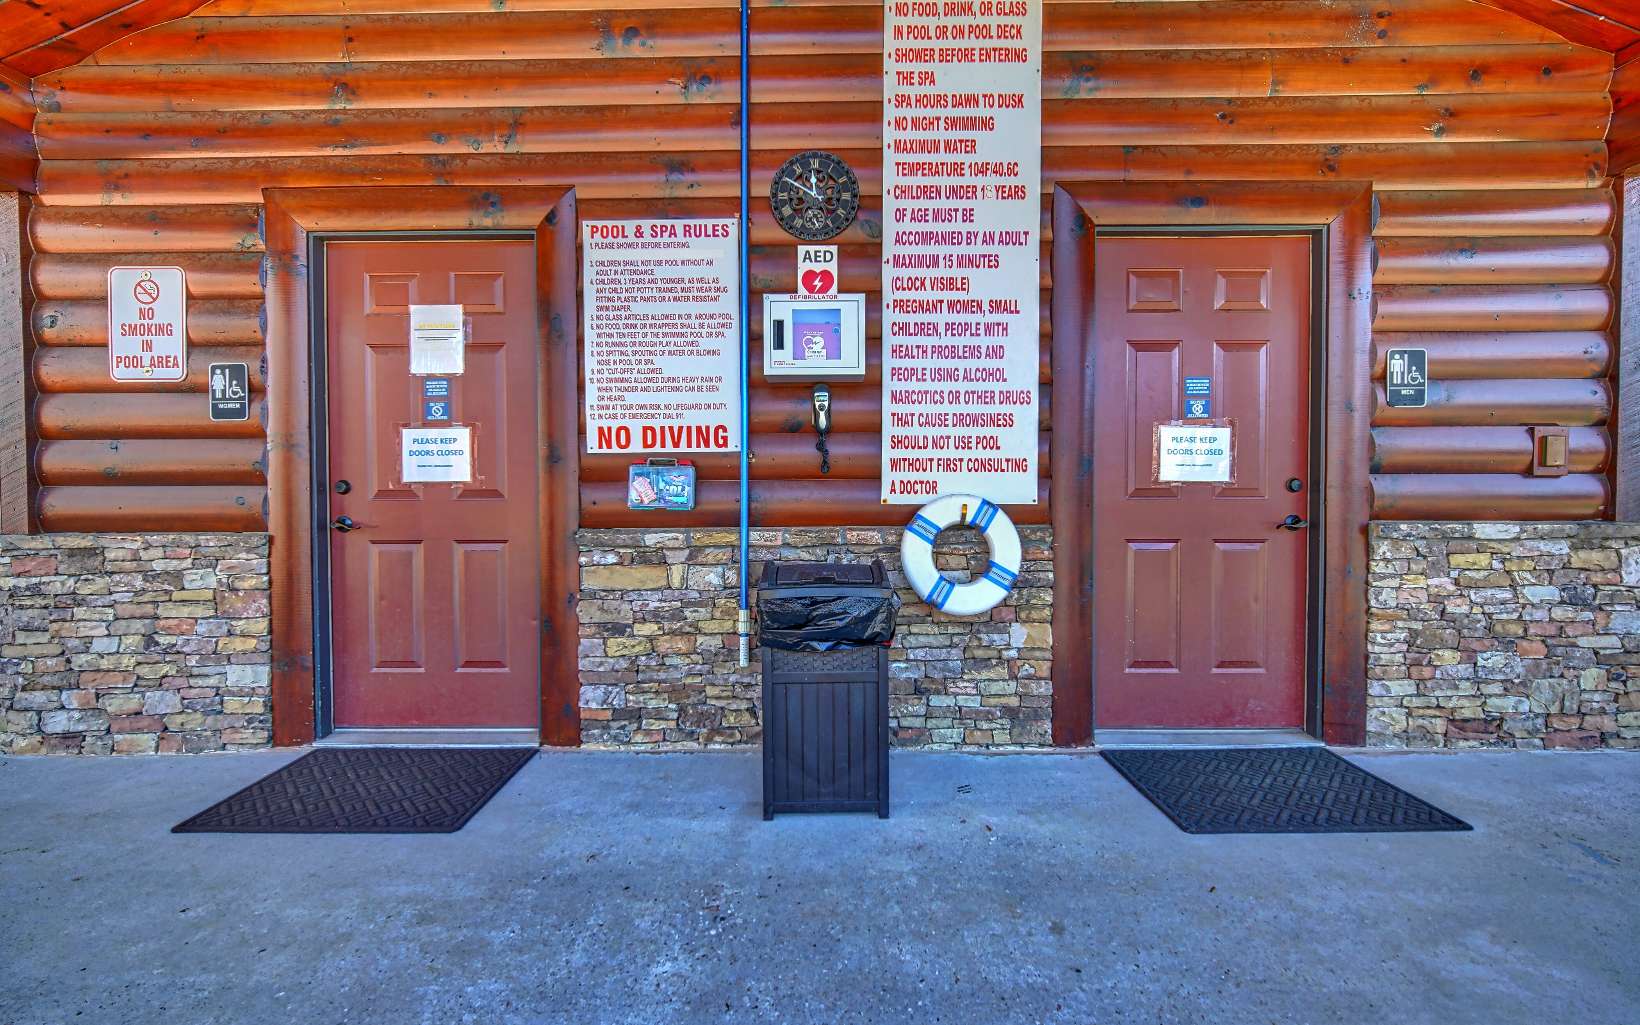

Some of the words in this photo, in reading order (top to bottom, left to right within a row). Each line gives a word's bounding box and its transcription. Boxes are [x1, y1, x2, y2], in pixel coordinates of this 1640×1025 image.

[895, 2, 908, 17] NO
[912, 2, 941, 20] FOOD,
[944, 2, 976, 19] DRINK,
[980, 2, 993, 16] OR
[996, 1, 1027, 16] GLASS
[894, 25, 903, 40] IN
[907, 25, 931, 40] POOL
[935, 25, 948, 40] OR
[952, 25, 964, 40] ON
[968, 25, 993, 40] POOL
[997, 25, 1022, 39] DECK
[895, 48, 935, 63] SHOWER
[939, 48, 975, 63] BEFORE
[979, 48, 1027, 63] ENTERING
[896, 71, 914, 86] THE
[918, 71, 935, 86] SPA
[895, 94, 912, 108] SPA
[915, 94, 948, 108] HOURS
[952, 94, 978, 108] DAWN
[982, 94, 994, 108] TO
[998, 94, 1024, 108] DUSK
[895, 116, 908, 131] NO
[911, 116, 941, 131] NIGHT
[944, 116, 995, 131] SWIMMING
[894, 139, 940, 153] MAXIMUM
[944, 139, 976, 153] WATER
[896, 162, 965, 177] TEMPERATURE
[968, 162, 1018, 177] 104F/40.6C
[894, 185, 941, 200] CHILDREN
[945, 185, 977, 200] UNDER
[994, 185, 1026, 200] YEARS
[895, 208, 907, 223] OF
[910, 208, 929, 223] AGE
[933, 208, 959, 223] MUST
[962, 208, 974, 223] BE
[590, 225, 628, 239] POOL
[634, 225, 644, 238] &
[651, 224, 677, 238] SPA
[684, 224, 729, 238] RULES
[895, 231, 962, 246] ACCOMPANIED
[966, 231, 978, 246] BY
[982, 231, 995, 246] AN
[998, 231, 1029, 246] ADULT
[802, 250, 833, 263] AED
[893, 254, 939, 268] MAXIMUM
[943, 254, 953, 268] 15
[957, 254, 999, 268] MINUTES
[892, 277, 926, 294] (CLOCK
[930, 277, 970, 294] VISIBLE)
[139, 308, 154, 320] NO
[893, 300, 944, 314] PREGNANT
[947, 300, 986, 317] WOMEN,
[988, 300, 1020, 314] SMALL
[121, 323, 173, 336] SMOKING
[891, 322, 941, 339] CHILDREN,
[945, 322, 980, 336] PEOPLE
[984, 322, 1008, 336] WITH
[142, 340, 152, 352] IN
[891, 345, 927, 359] HEALTH
[931, 345, 982, 359] PROBLEMS
[985, 345, 1004, 359] AND
[116, 356, 145, 368] POOL
[150, 356, 179, 368] AREA
[891, 368, 926, 382] PEOPLE
[930, 368, 959, 382] USING
[962, 368, 1007, 382] ALCOHOL
[891, 390, 944, 405] NARCOTICS
[948, 390, 960, 405] OR
[964, 390, 995, 405] OTHER
[999, 390, 1031, 405] DRUGS
[891, 413, 915, 427] THAT
[918, 413, 949, 427] CAUSE
[952, 413, 1014, 427] DROWSINESS
[598, 426, 630, 449] NO
[642, 425, 728, 448] DIVING
[891, 436, 928, 450] SHOULD
[932, 436, 951, 450] NOT
[954, 436, 972, 450] USE
[976, 436, 1000, 450] POOL
[890, 458, 934, 472] WITHOUT
[937, 458, 964, 472] FIRST
[967, 458, 1028, 472] CONSULTING
[890, 480, 896, 494] A
[900, 480, 937, 494] DOCTOR
